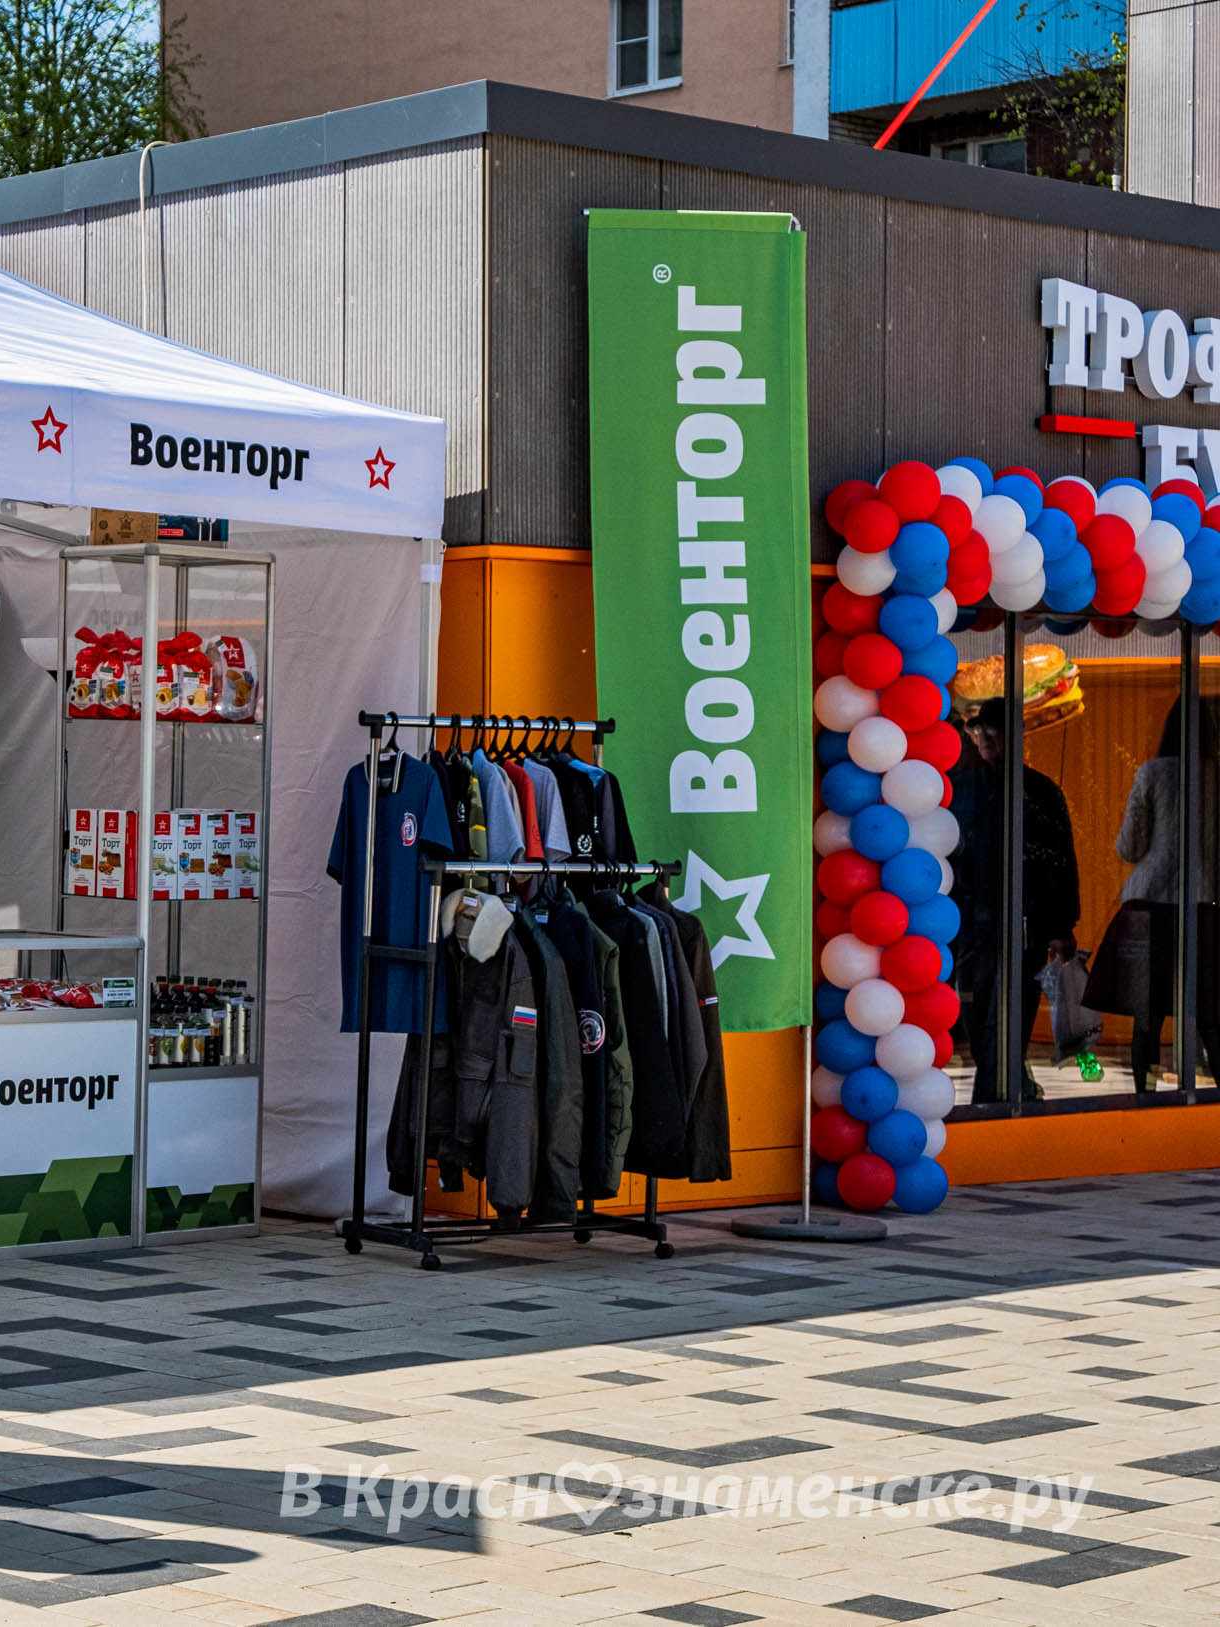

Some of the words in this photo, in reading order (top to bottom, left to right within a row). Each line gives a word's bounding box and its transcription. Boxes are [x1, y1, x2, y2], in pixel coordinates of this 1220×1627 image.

[130, 423, 310, 490] Военторг
[668, 285, 767, 813] Военторг
[102, 837, 121, 850] Торт
[182, 839, 203, 850] Торт
